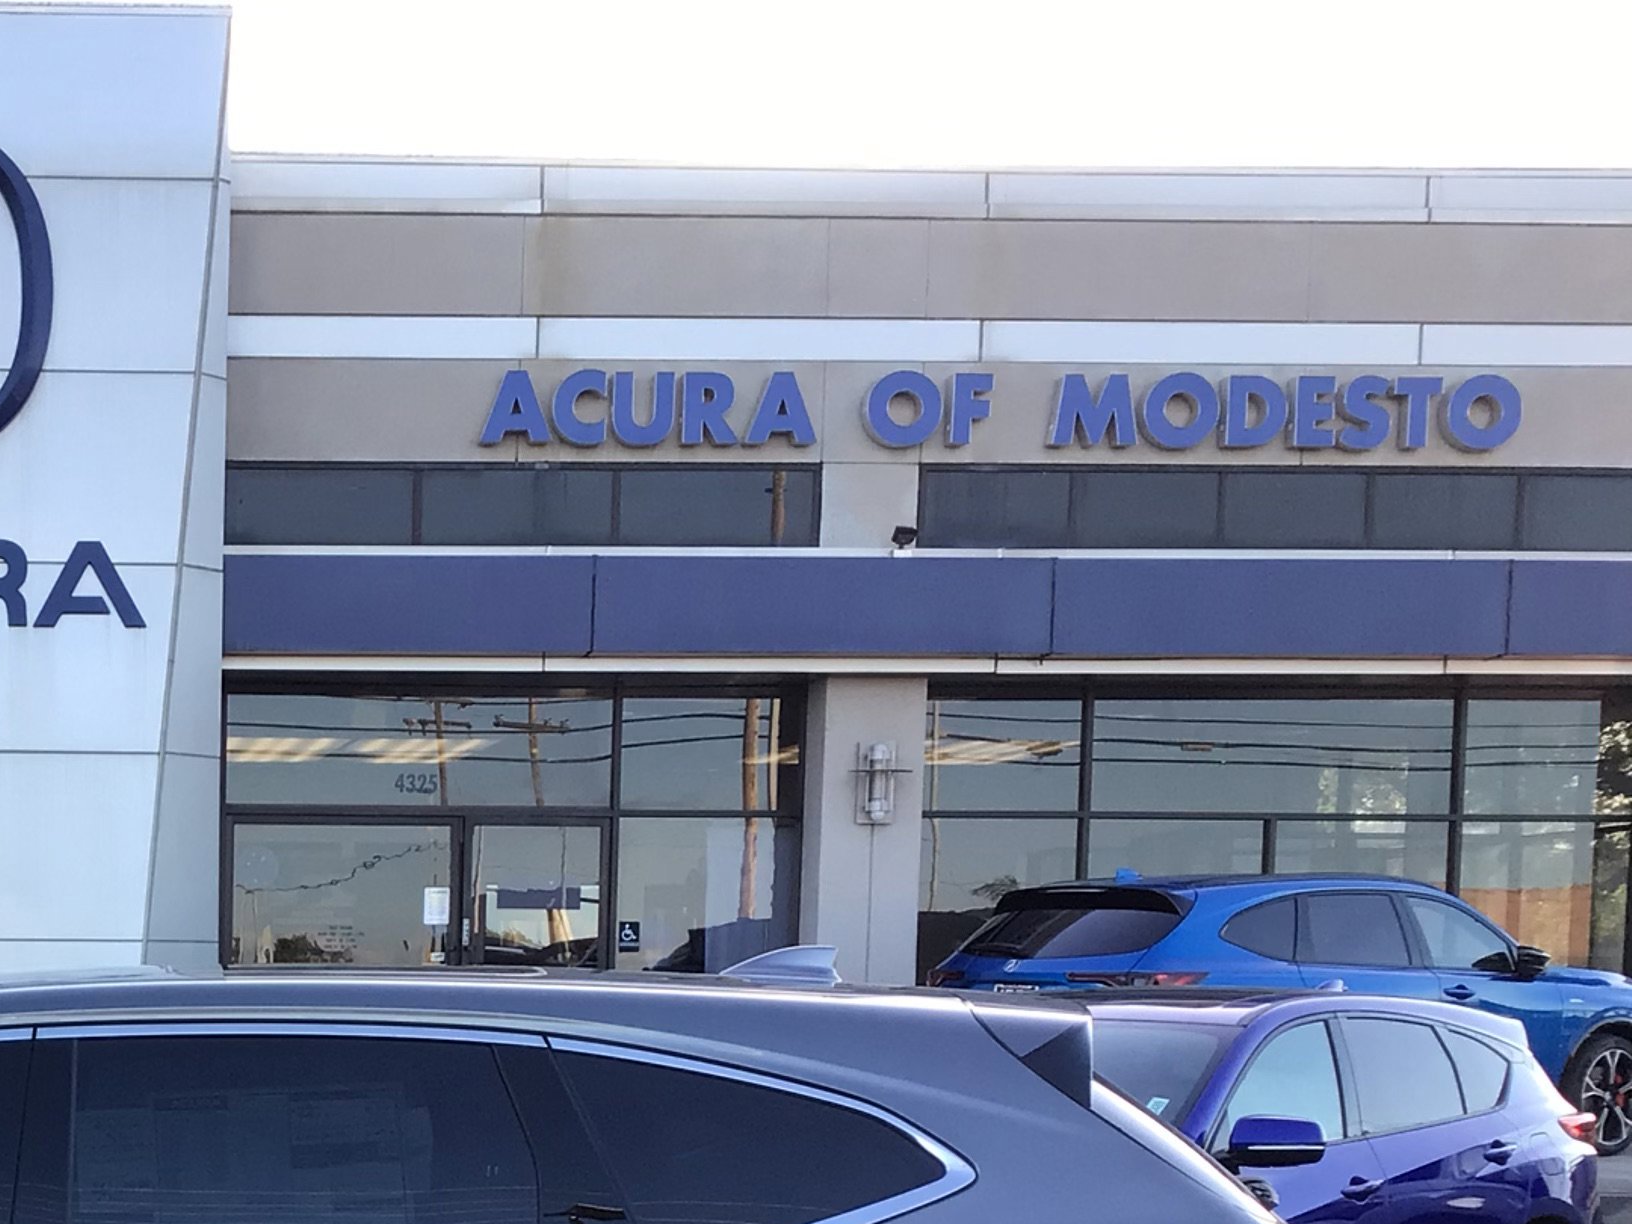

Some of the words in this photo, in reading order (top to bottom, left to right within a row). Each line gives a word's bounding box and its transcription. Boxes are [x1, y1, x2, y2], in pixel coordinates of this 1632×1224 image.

[479, 369, 817, 447] ACURA
[861, 369, 994, 448] OF
[1045, 372, 1522, 451] MODESTO
[394, 773, 438, 794] 4325
